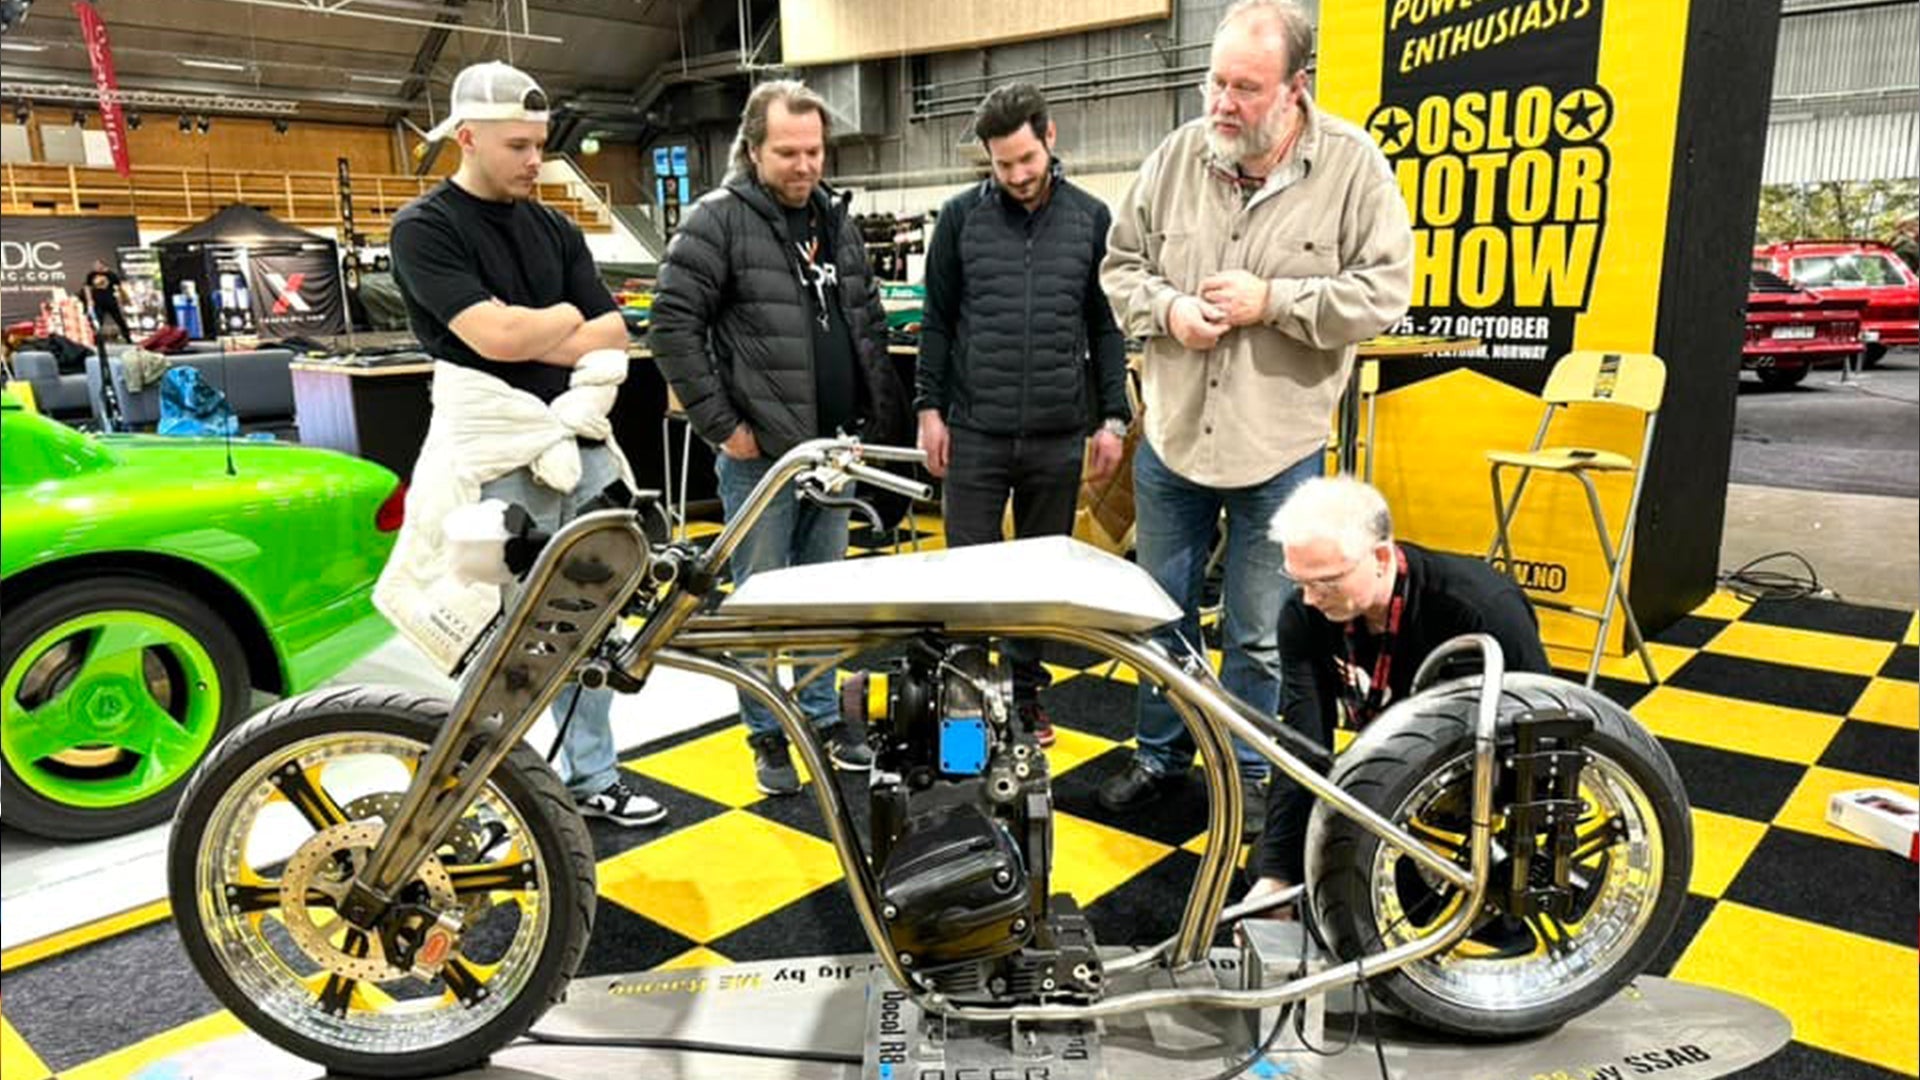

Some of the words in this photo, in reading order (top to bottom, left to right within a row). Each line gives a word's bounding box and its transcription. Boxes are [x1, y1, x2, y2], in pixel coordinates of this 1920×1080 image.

[1416, 86, 1551, 155] OSLO
[1410, 223, 1598, 308] HOW
[1429, 315, 1453, 335] 27
[1455, 315, 1550, 340] OCTOBER
[1623, 1044, 1712, 1074] SSAB
